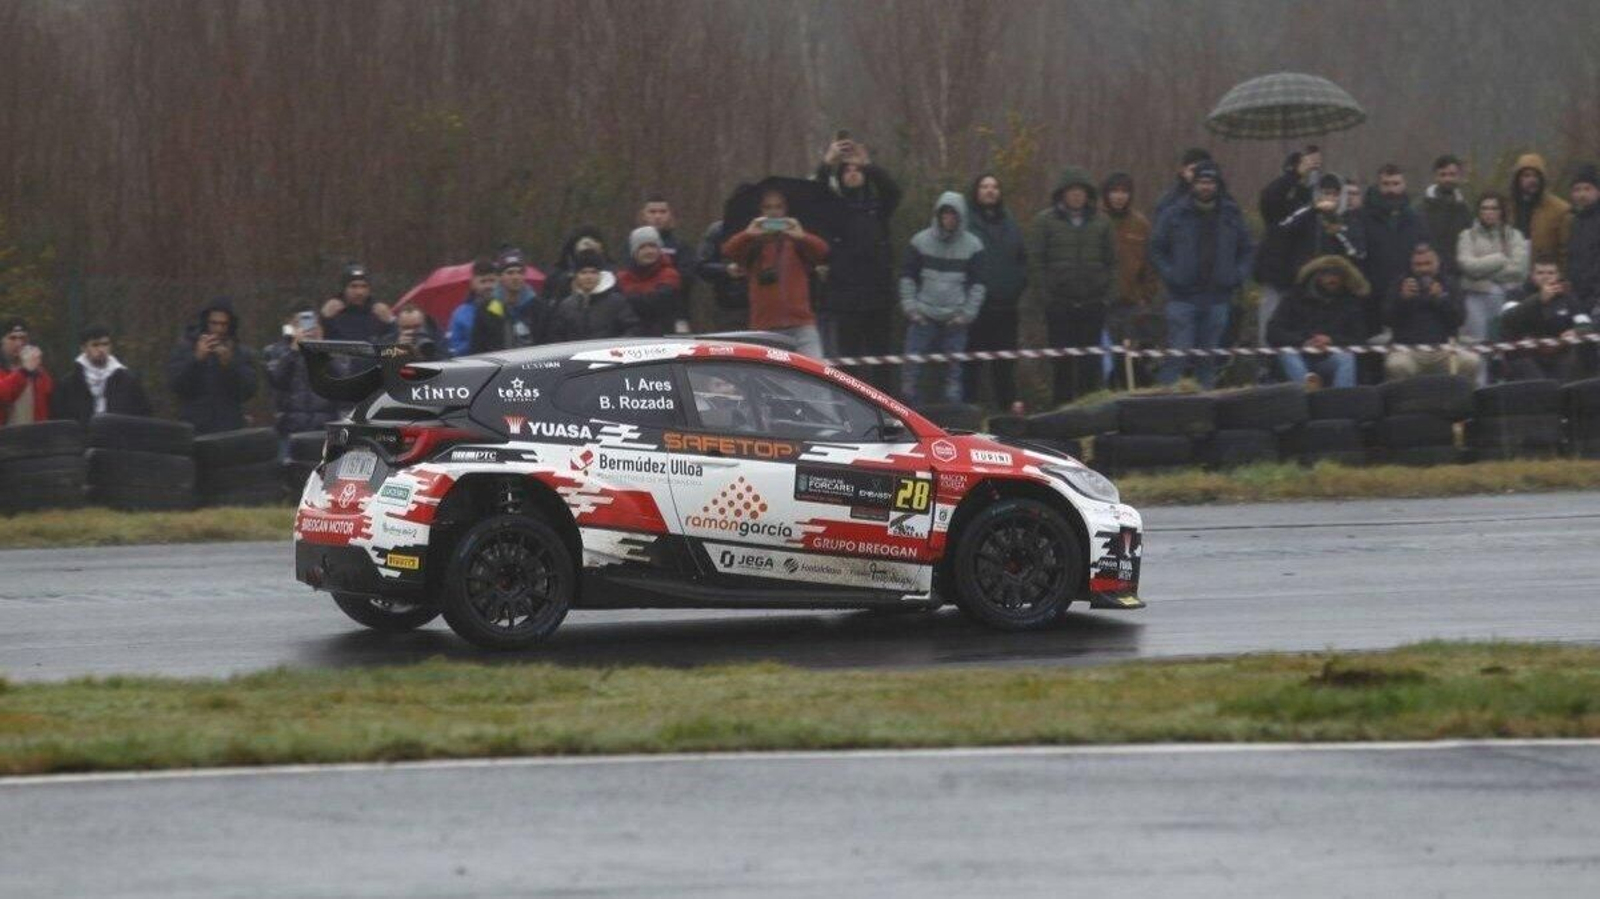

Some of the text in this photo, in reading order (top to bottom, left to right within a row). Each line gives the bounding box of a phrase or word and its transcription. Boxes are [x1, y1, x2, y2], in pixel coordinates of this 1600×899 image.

[499, 388, 540, 398] texas
[624, 378, 672, 391] I. Ares
[600, 397, 674, 410] B. Rozada
[528, 422, 593, 440] YUASA
[663, 432, 792, 457] SAFETOP
[599, 453, 703, 477] Bermúdez Ulloa
[896, 479, 930, 511] 28
[329, 519, 354, 535] MOTOR
[685, 513, 793, 538] ramóngarcía
[813, 537, 856, 552] GRUPO
